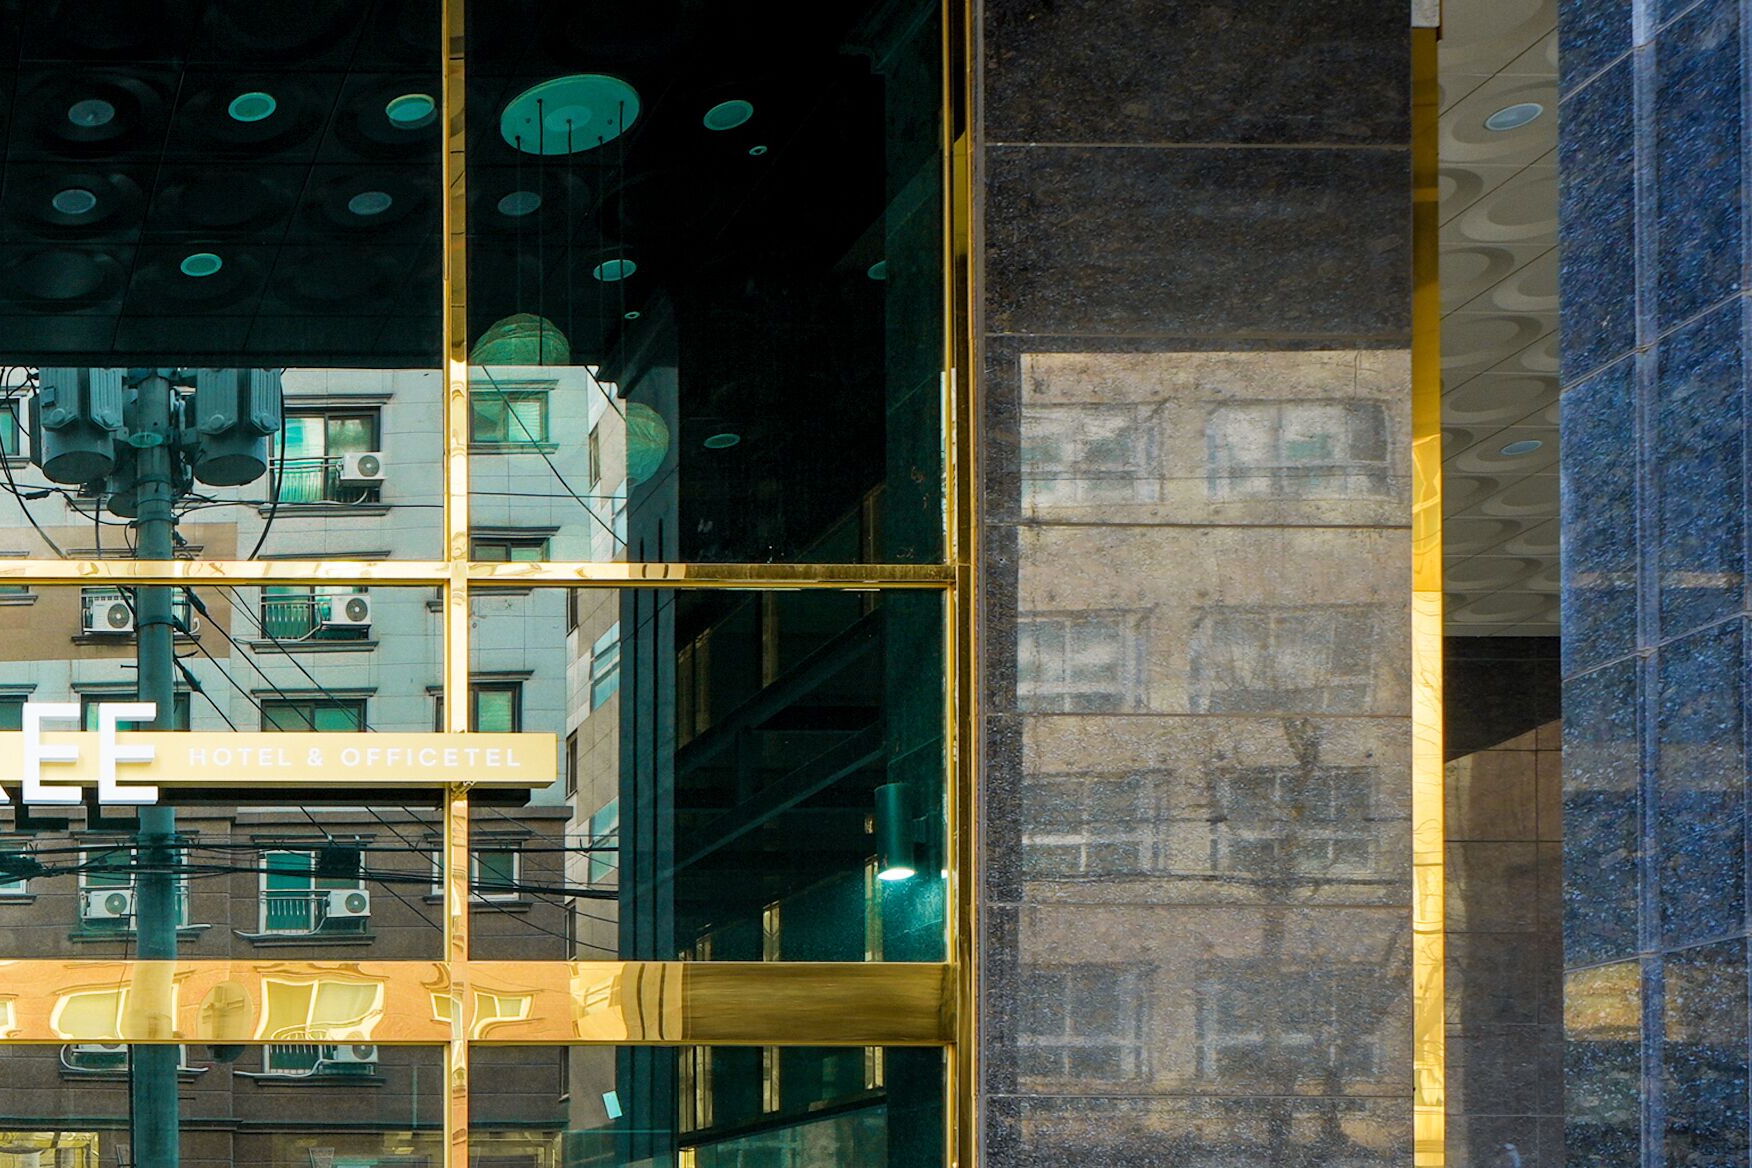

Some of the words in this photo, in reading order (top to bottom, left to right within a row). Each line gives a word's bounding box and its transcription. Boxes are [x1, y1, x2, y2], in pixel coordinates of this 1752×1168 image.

[188, 747, 292, 767] HOTEL
[306, 747, 325, 767] &
[340, 747, 521, 767] OFFICETEL
